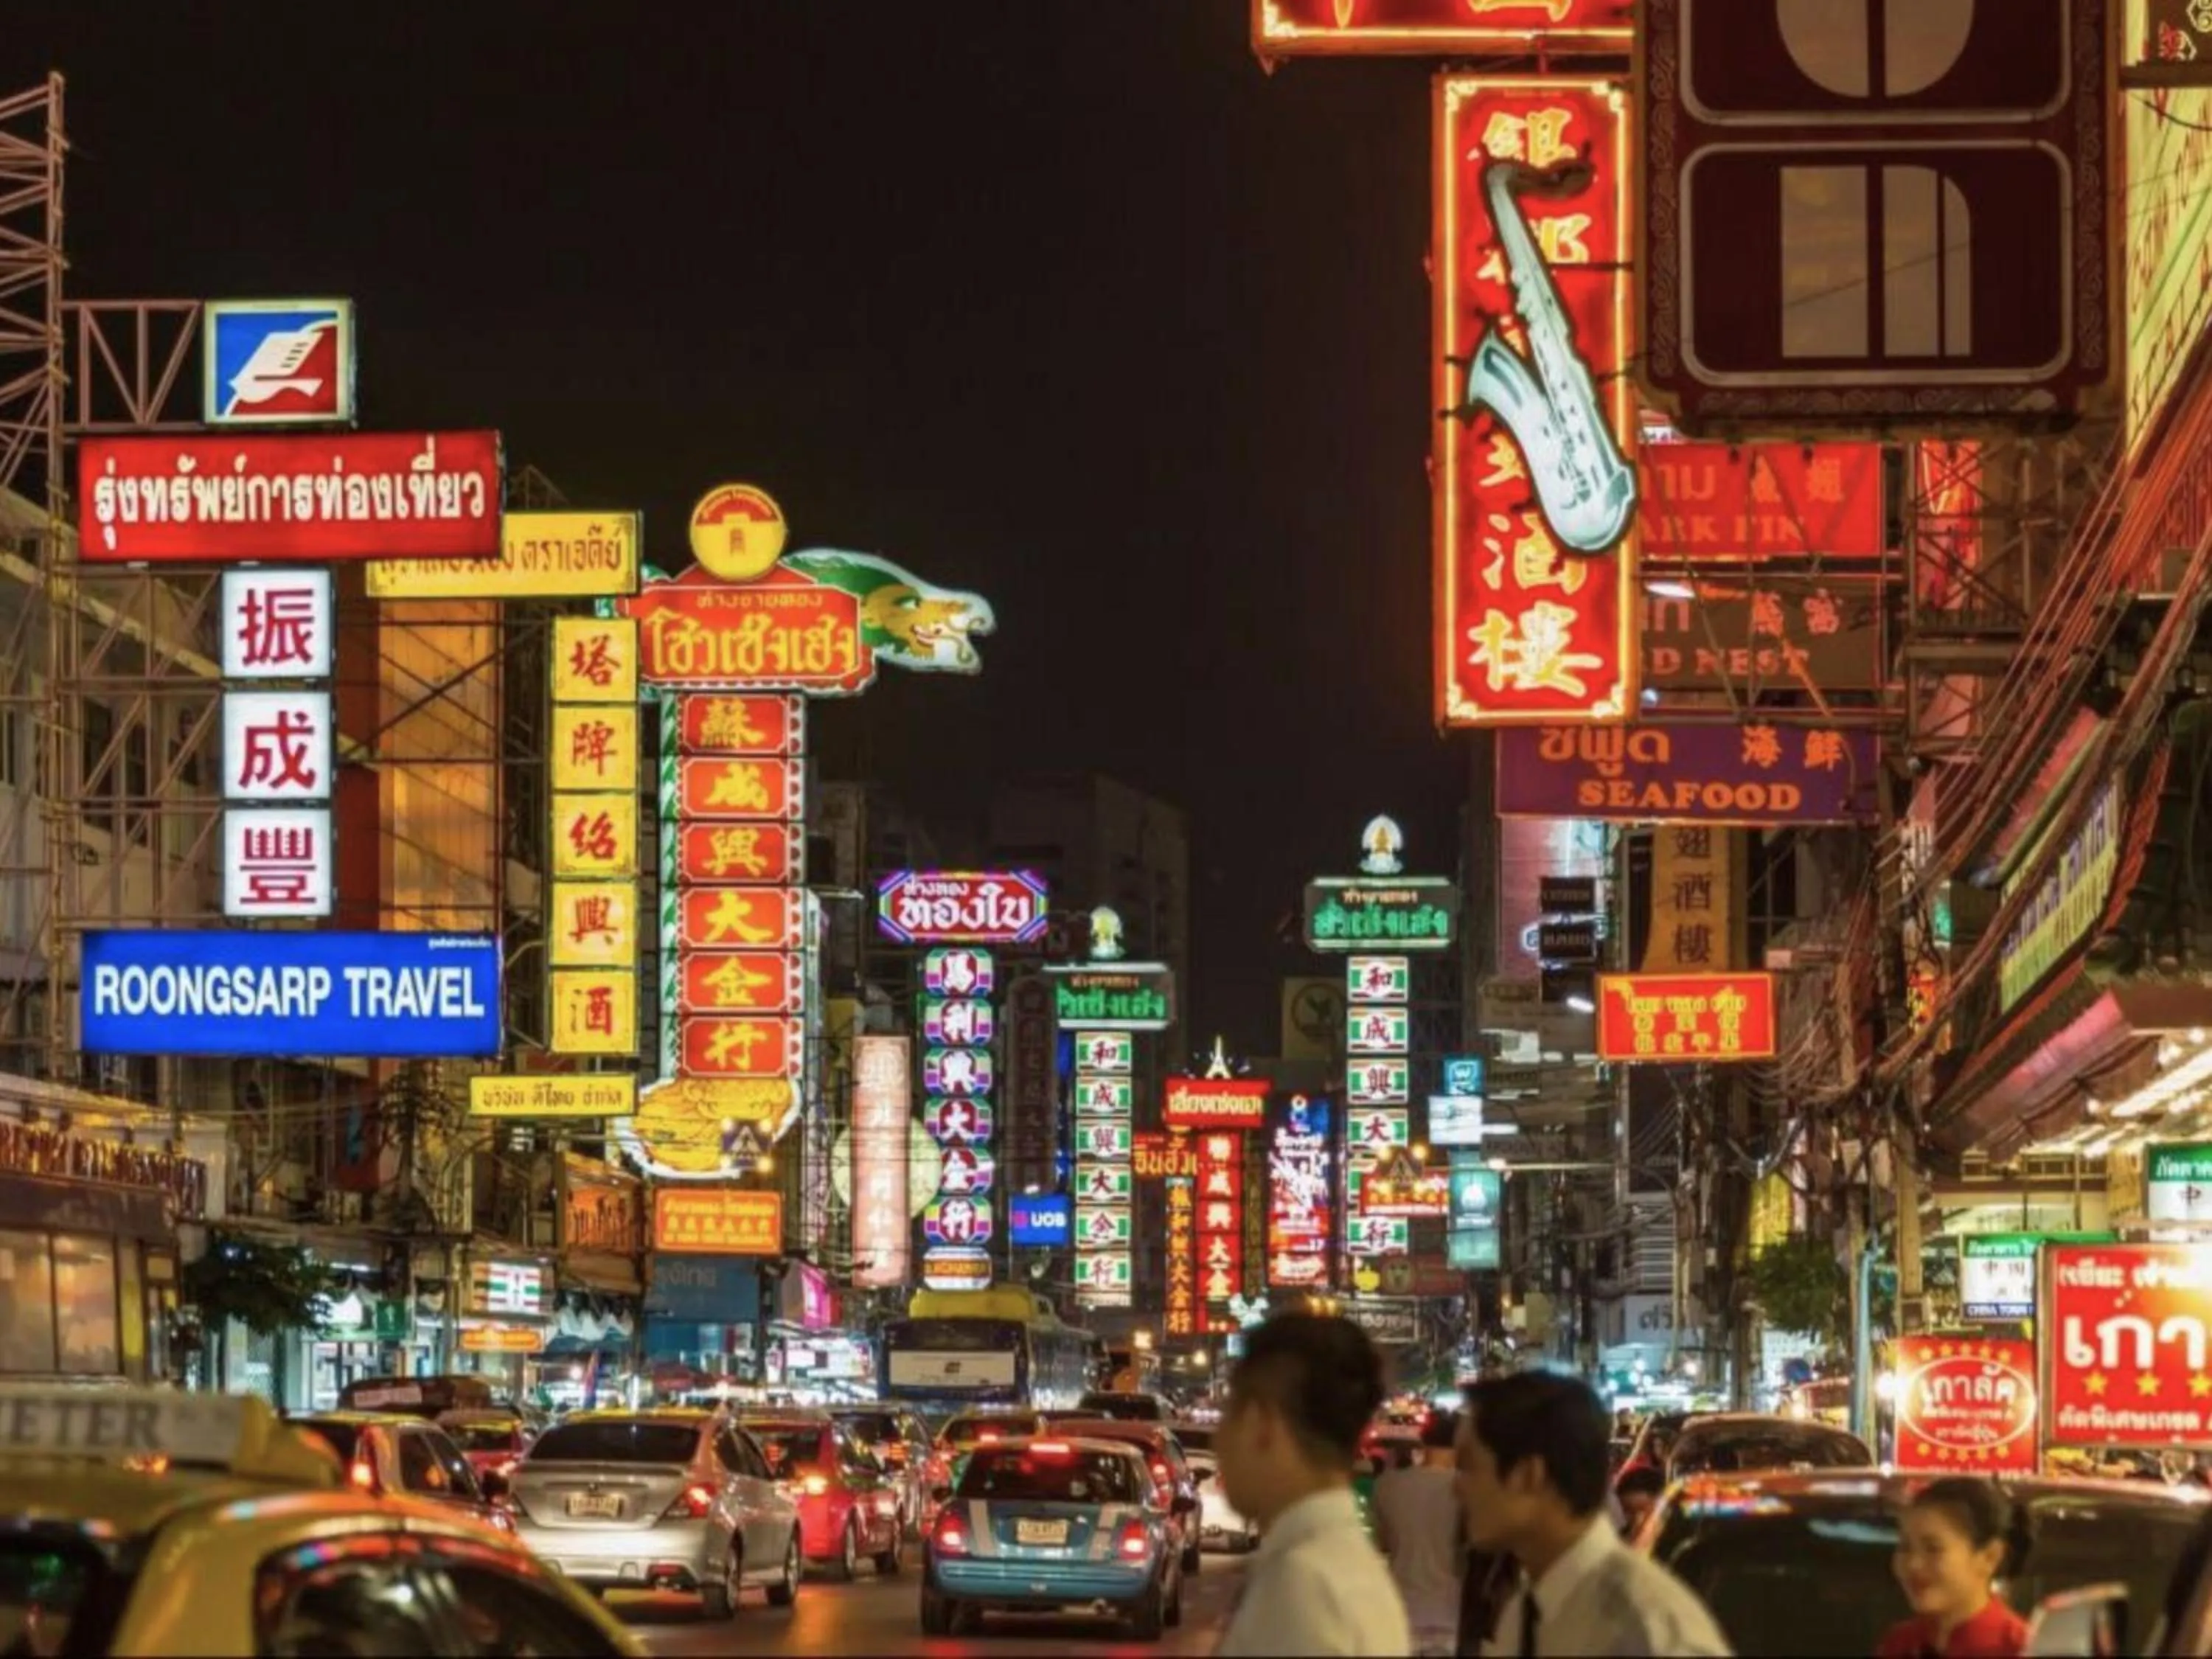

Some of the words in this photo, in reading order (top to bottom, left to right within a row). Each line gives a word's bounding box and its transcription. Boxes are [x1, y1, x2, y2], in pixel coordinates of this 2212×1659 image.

[93, 434, 484, 549] รุ่งทรัพย์การท่องเที่ยว
[1578, 779, 1801, 811] SEAFOOD
[94, 964, 331, 1018] ROONGSARP
[343, 966, 484, 1018] TRAVEL
[1030, 1211, 1066, 1228] UOB
